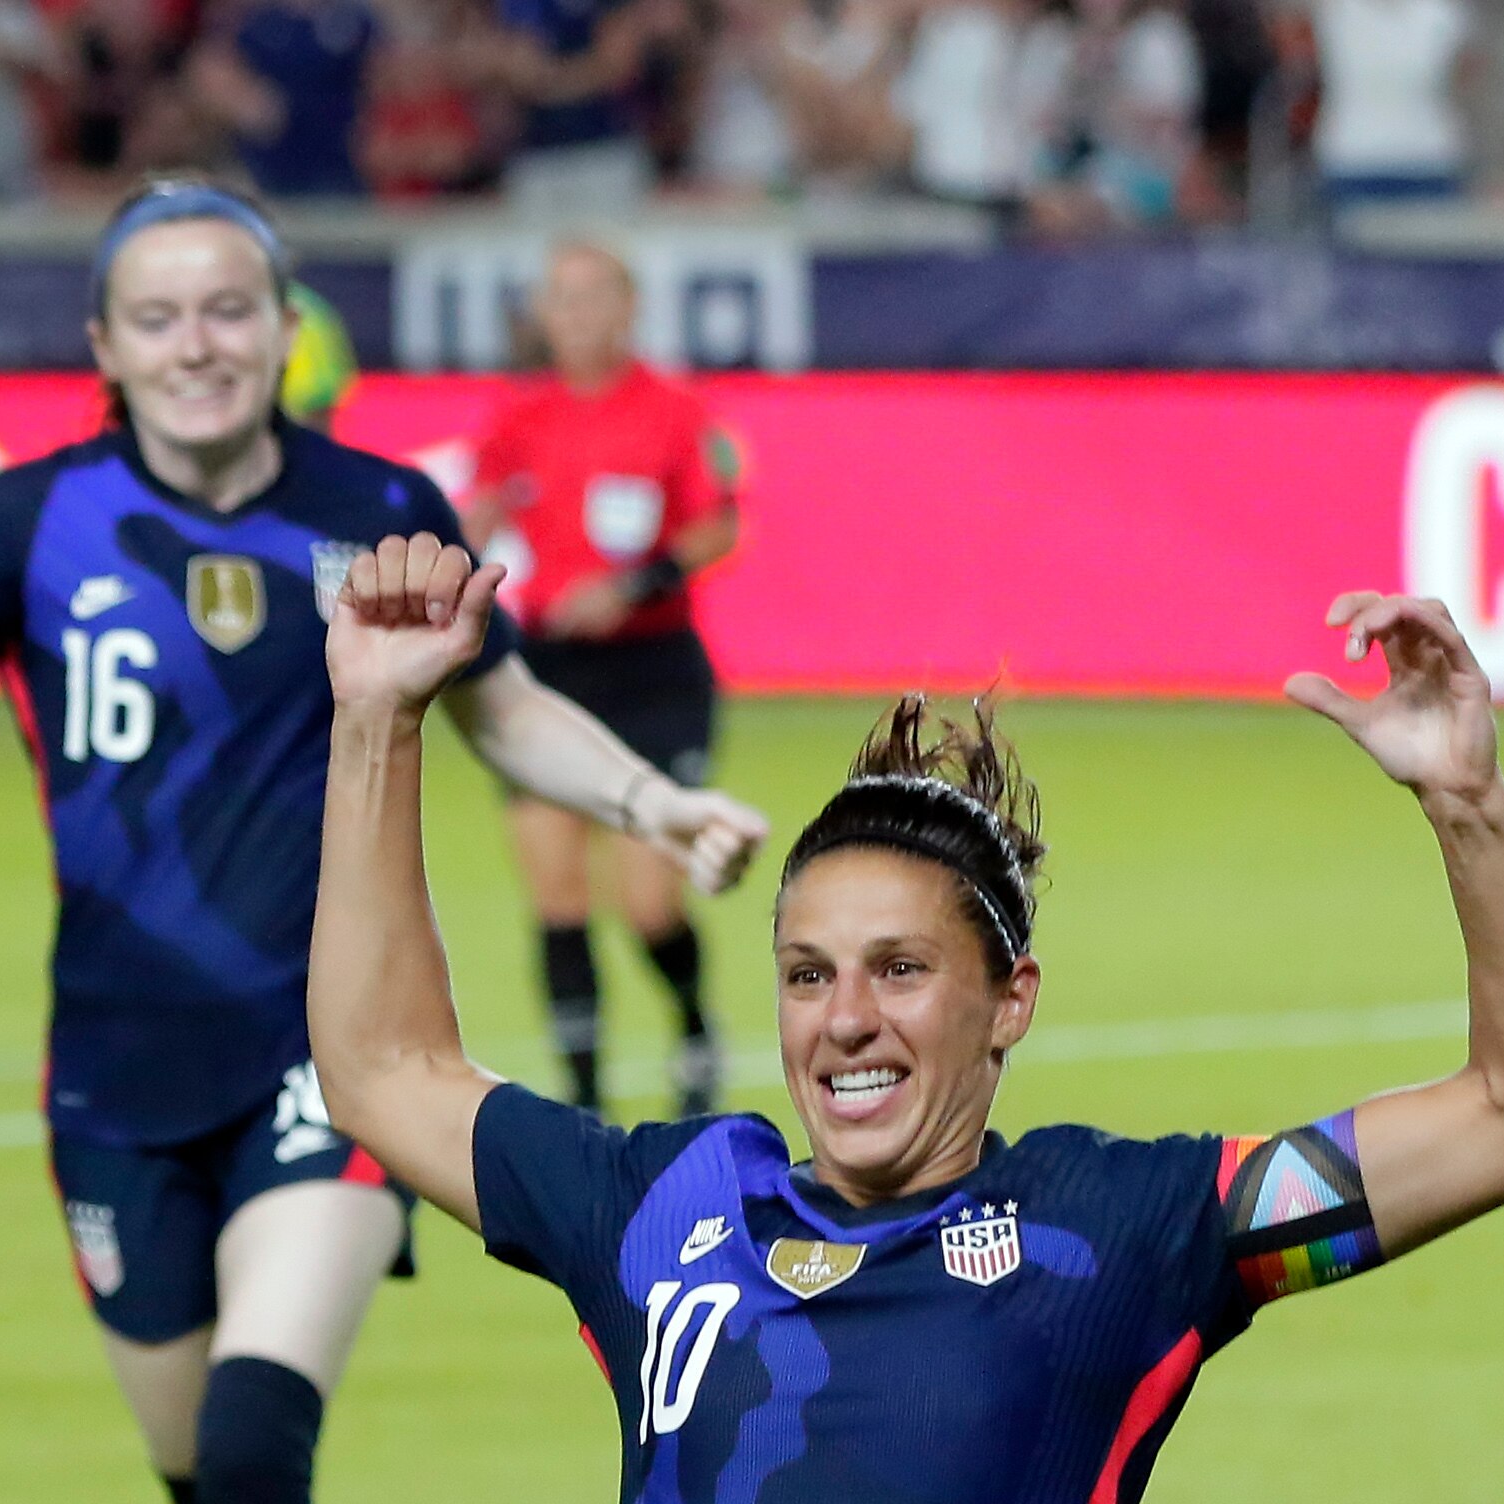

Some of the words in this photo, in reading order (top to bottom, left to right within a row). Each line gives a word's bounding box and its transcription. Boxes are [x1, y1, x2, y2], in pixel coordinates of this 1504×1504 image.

[61, 627, 158, 764] 16
[689, 1214, 726, 1249] NIKE
[946, 1222, 1012, 1249] USA
[791, 1262, 832, 1277] FIFA
[639, 1280, 742, 1446] 10
